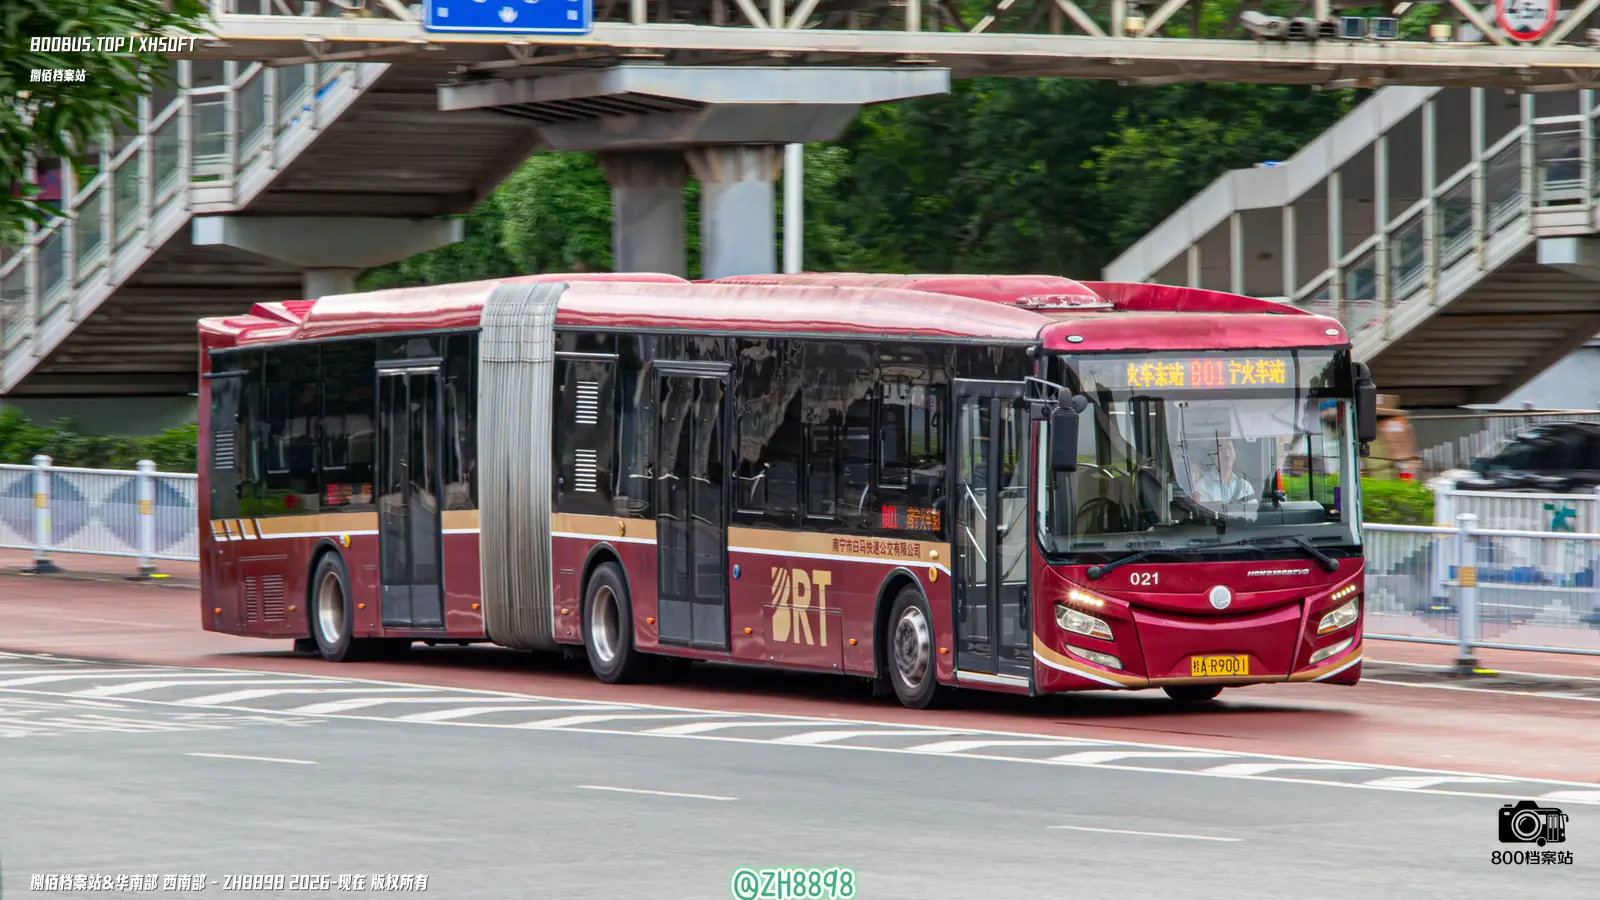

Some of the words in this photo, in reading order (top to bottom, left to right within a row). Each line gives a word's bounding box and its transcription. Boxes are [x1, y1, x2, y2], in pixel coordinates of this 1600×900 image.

[1189, 359, 1225, 387] B01
[832, 537, 921, 559] 南宁市白马快速公交有限公司
[1130, 571, 1159, 586] 021
[771, 566, 832, 647] BRT
